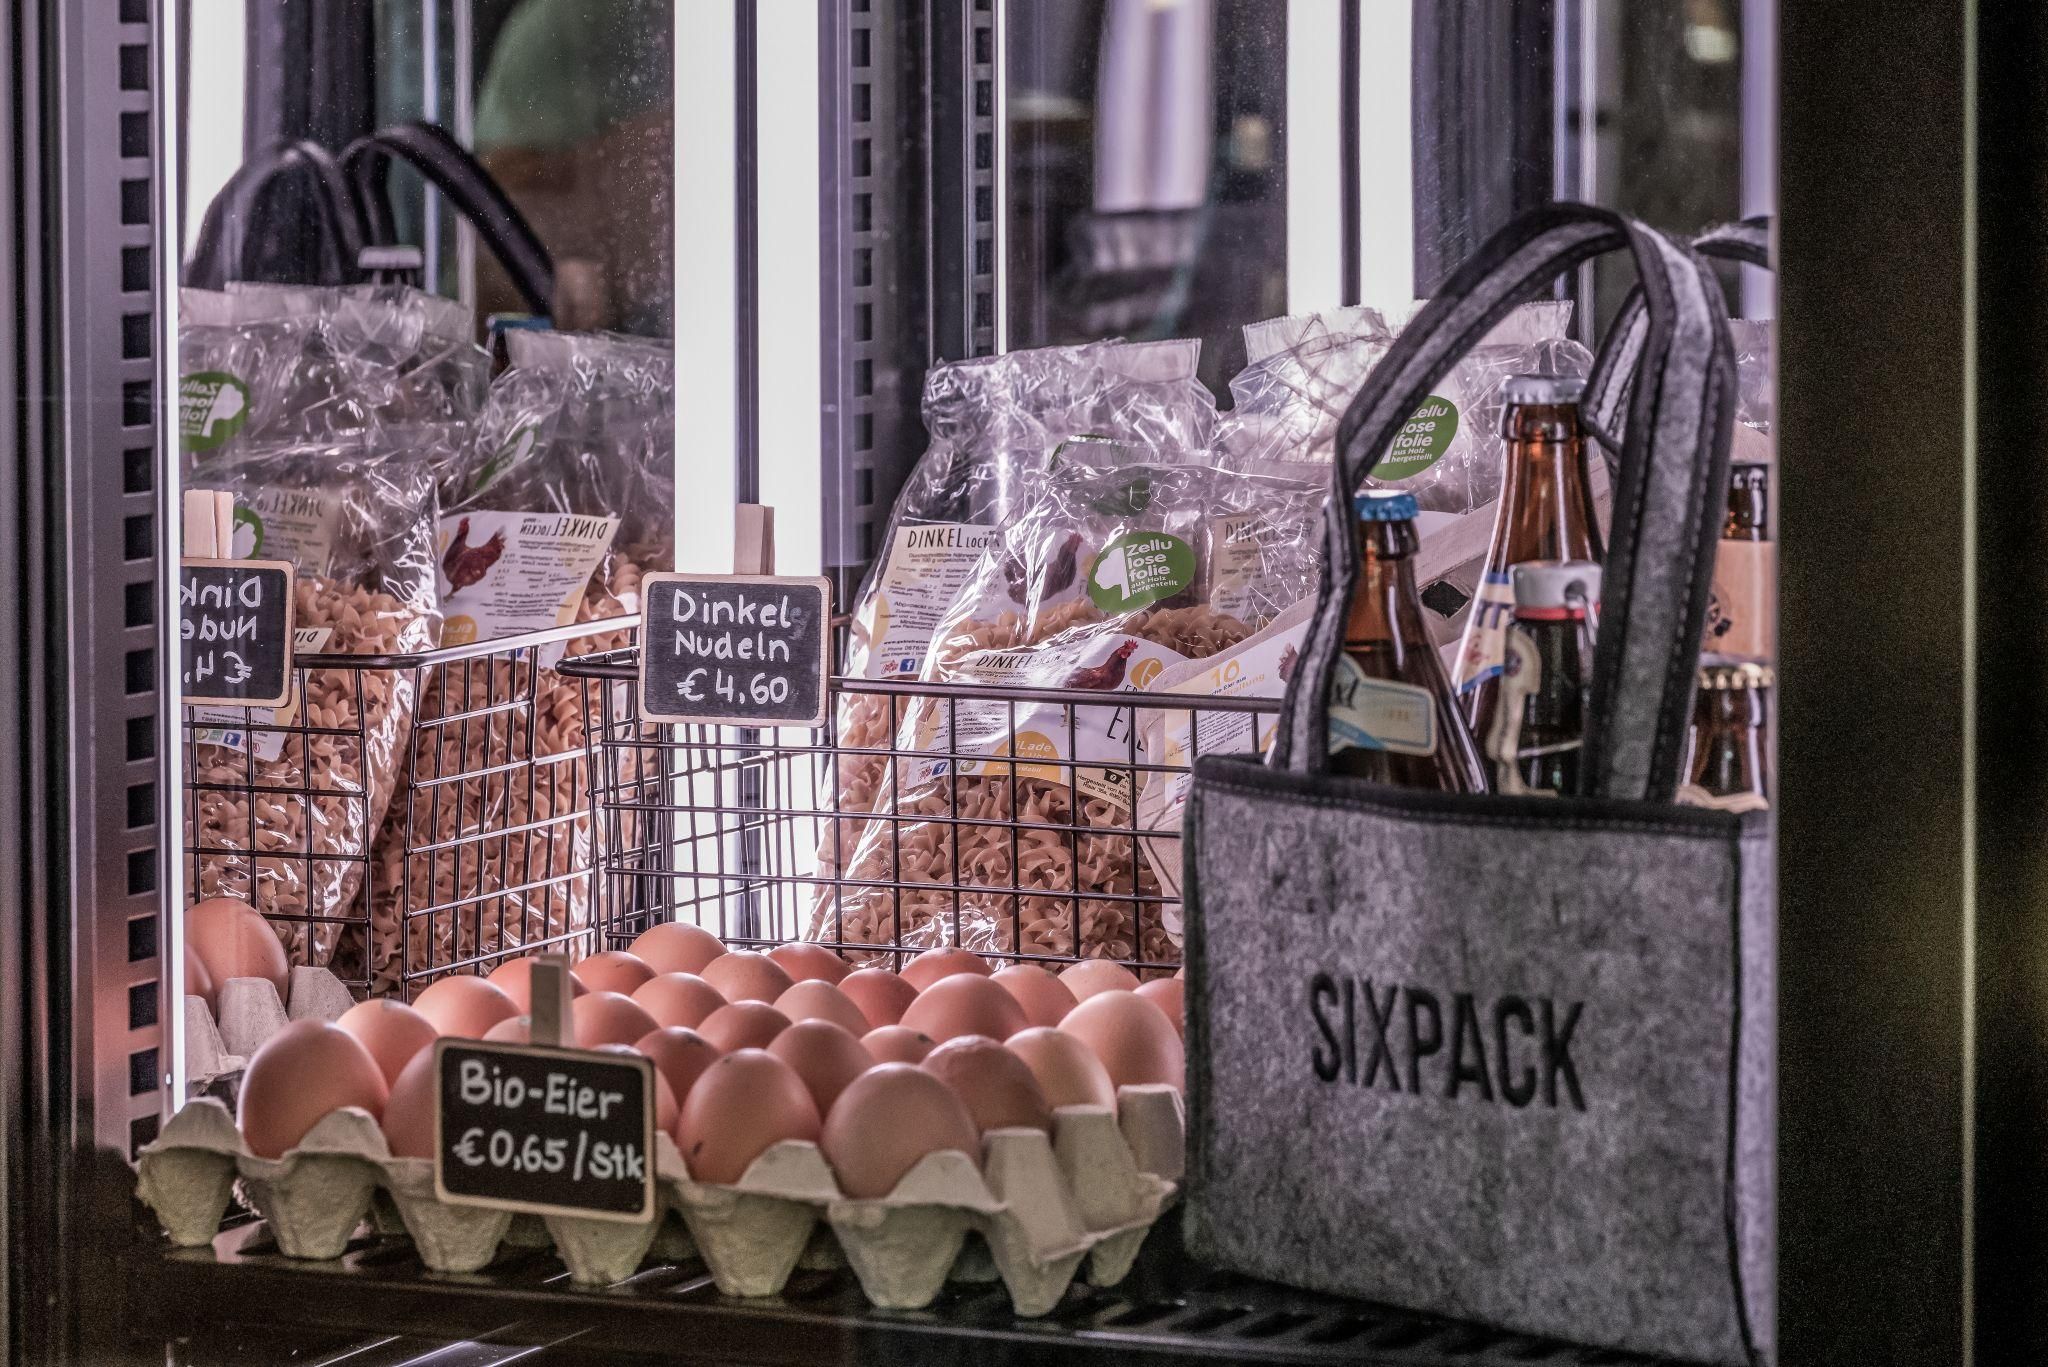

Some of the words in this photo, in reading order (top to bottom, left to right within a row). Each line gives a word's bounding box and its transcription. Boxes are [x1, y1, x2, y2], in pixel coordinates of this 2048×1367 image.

[1401, 421, 1436, 433] lose
[1395, 433, 1433, 448] folie
[1391, 453, 1432, 463] hergestellt
[1408, 447, 1425, 455] Holz
[907, 527, 963, 549] DINKEL
[1126, 539, 1173, 557] Zellu
[1127, 553, 1167, 569] lose
[1129, 565, 1171, 582] folie
[1130, 580, 1145, 589] aus
[1147, 575, 1167, 583] Holz
[1131, 580, 1178, 595] hergestellt
[673, 588, 791, 628] Dinkel
[675, 629, 790, 662] Nudeln
[975, 654, 1033, 669] DINKEL
[1210, 659, 1240, 687] 10
[1014, 740, 1052, 752] iLade
[1310, 971, 1588, 1113] SIXPACK
[460, 1058, 624, 1121] Bio-Eier
